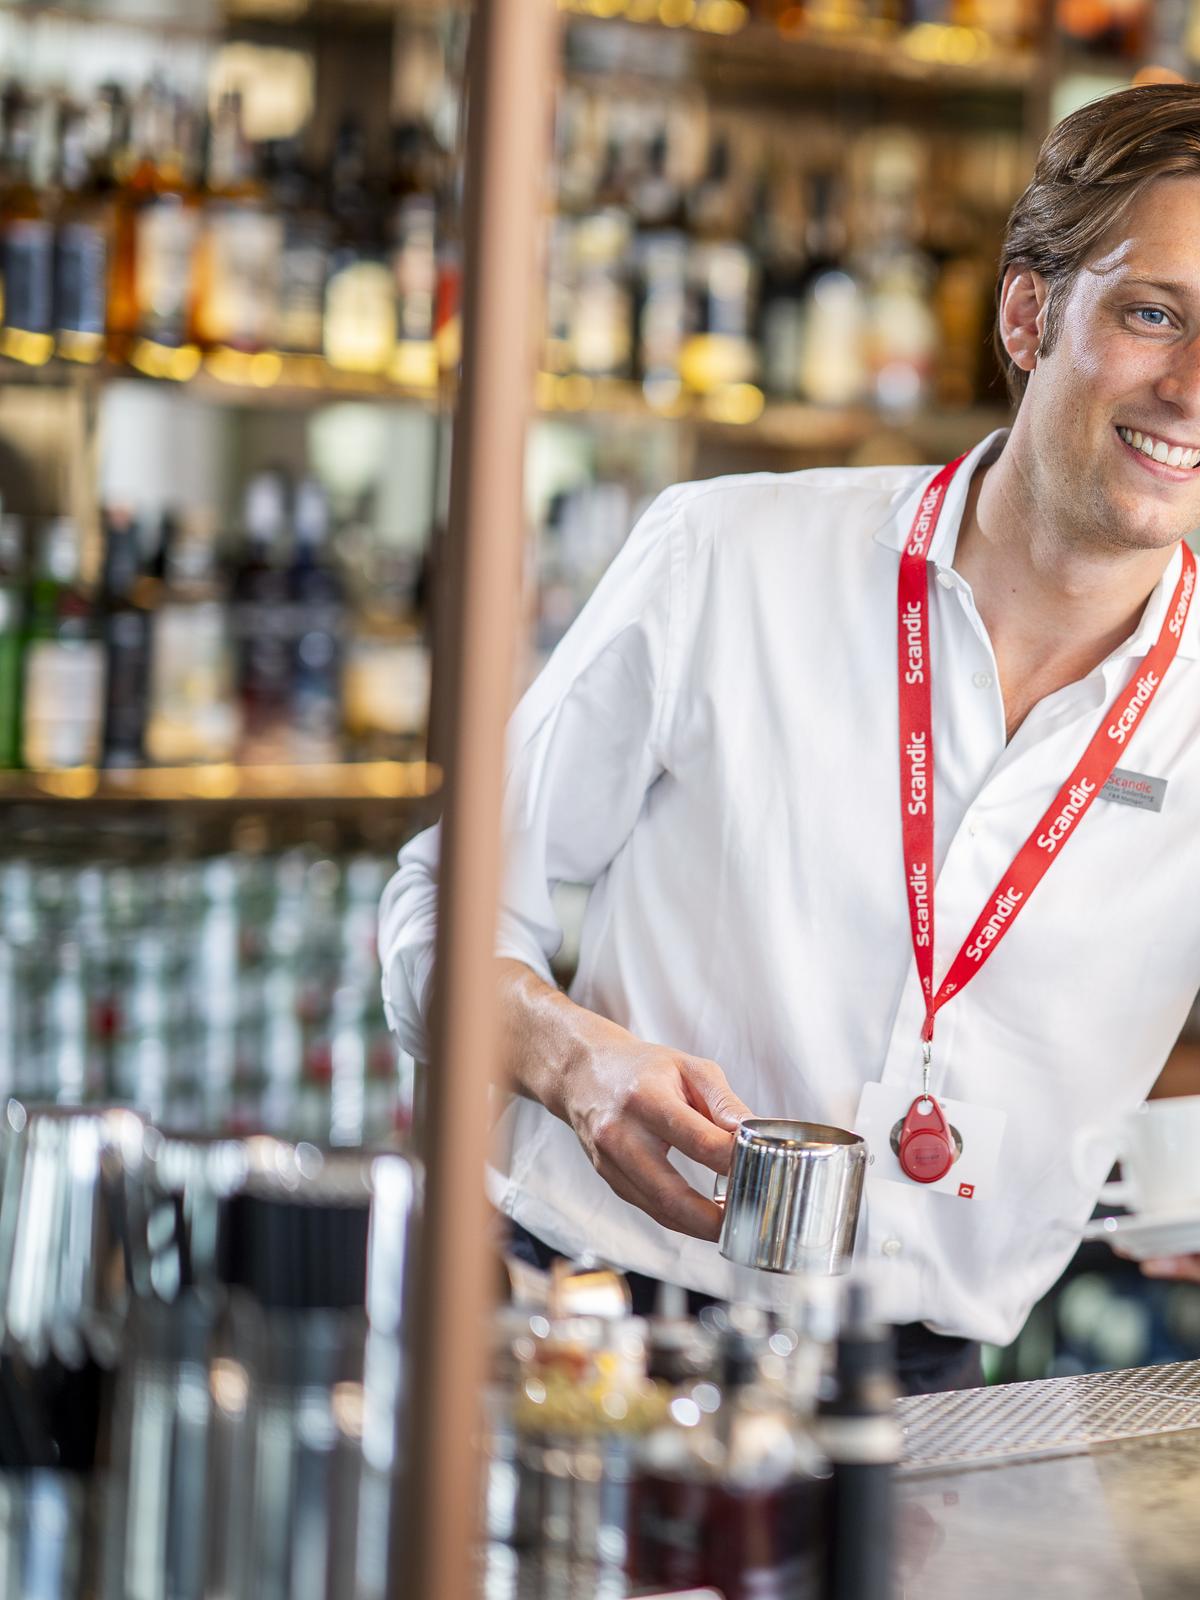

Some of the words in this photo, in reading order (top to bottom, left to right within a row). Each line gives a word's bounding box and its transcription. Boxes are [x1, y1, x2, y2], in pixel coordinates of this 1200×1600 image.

[907, 484, 943, 557] Scandic
[1168, 565, 1195, 639] Scandic
[902, 601, 923, 684] Scandic
[1107, 671, 1159, 744] Scandic
[906, 731, 927, 816] Scandic
[1107, 774, 1153, 793] Scandic
[1036, 776, 1096, 853] Scandic
[909, 863, 929, 948] Scandic
[965, 886, 1023, 962] Scandic
